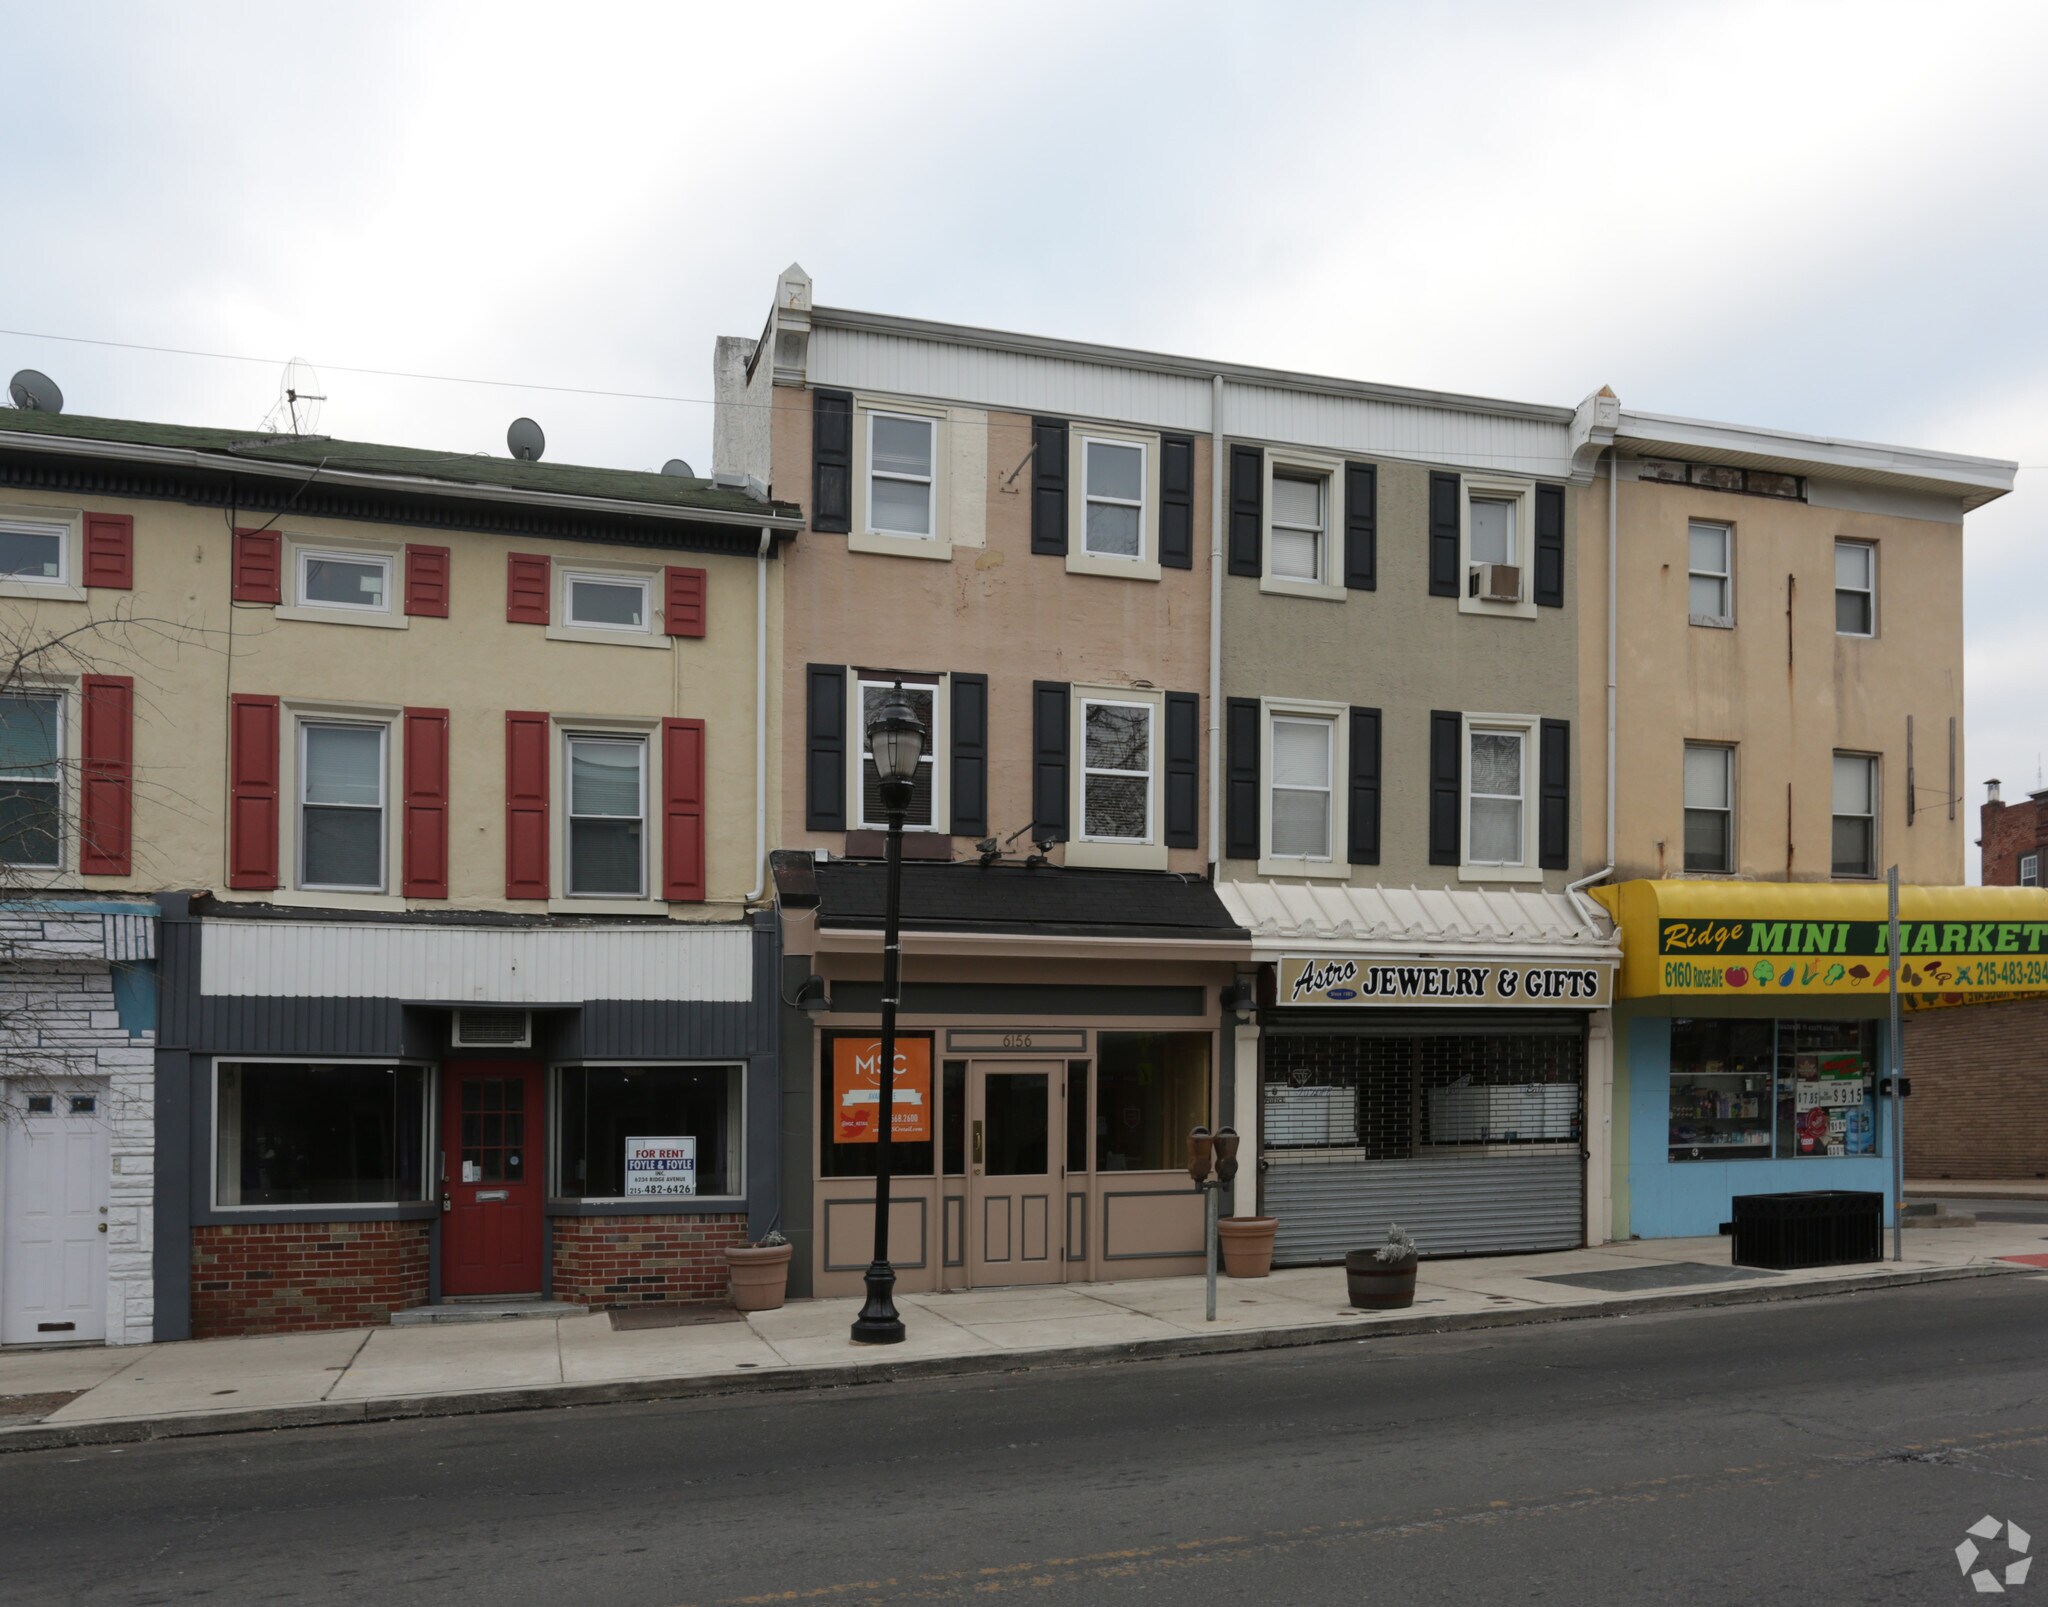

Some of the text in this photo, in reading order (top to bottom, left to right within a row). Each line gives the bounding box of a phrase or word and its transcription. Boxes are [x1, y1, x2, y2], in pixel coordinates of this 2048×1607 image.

[1663, 921, 2048, 954] Ridge MINI MARKET
[1292, 960, 1357, 1000] Astro
[1362, 967, 1599, 999] JEWELRY & GIFTS
[1665, 962, 1692, 988] 6160
[1003, 1034, 1032, 1048] 6156
[636, 1150, 684, 1158] FOR RENT
[630, 1160, 692, 1170] FOYLE & FOYLE
[629, 1184, 691, 1194] 215-482-6426
